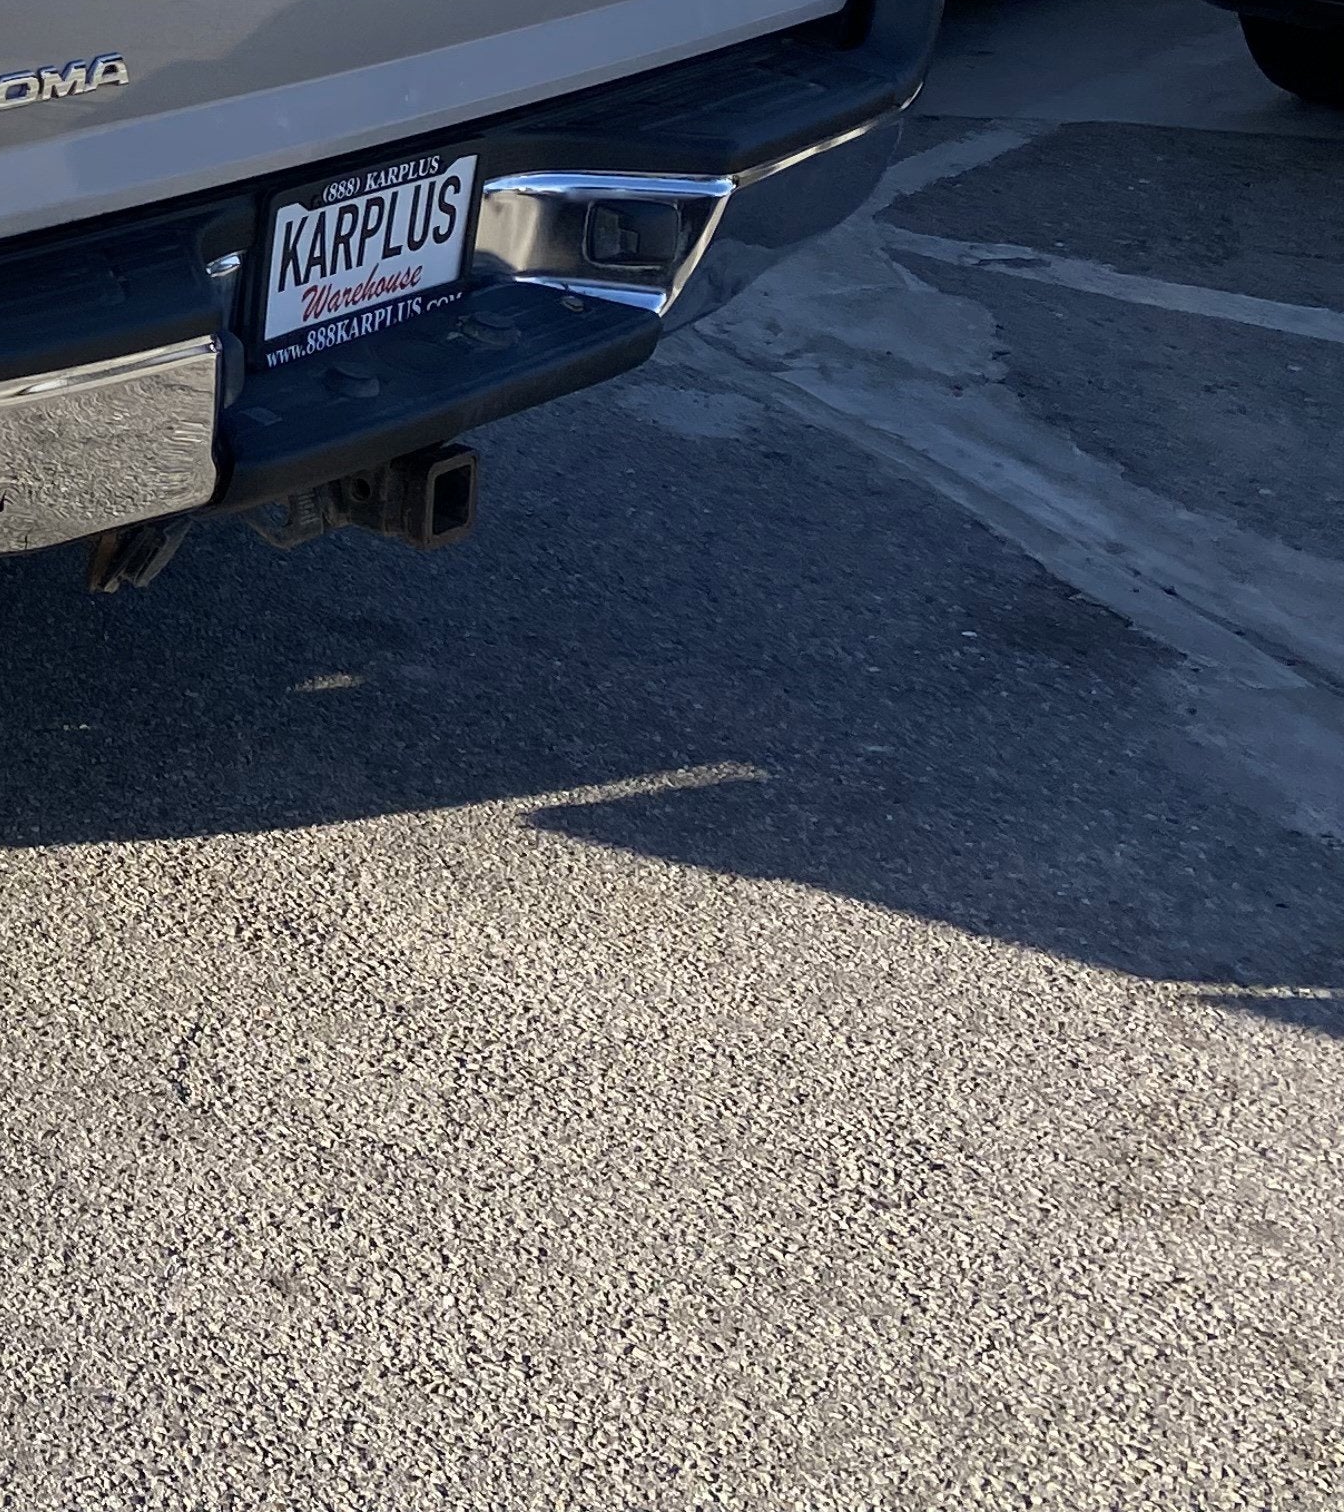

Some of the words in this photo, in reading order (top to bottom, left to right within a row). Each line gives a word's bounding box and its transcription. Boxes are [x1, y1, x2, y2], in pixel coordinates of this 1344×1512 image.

[322, 176, 361, 204] (888)
[365, 155, 440, 192] KARPLUS
[277, 175, 462, 293] KARPLUS
[301, 263, 424, 323] Warehouse
